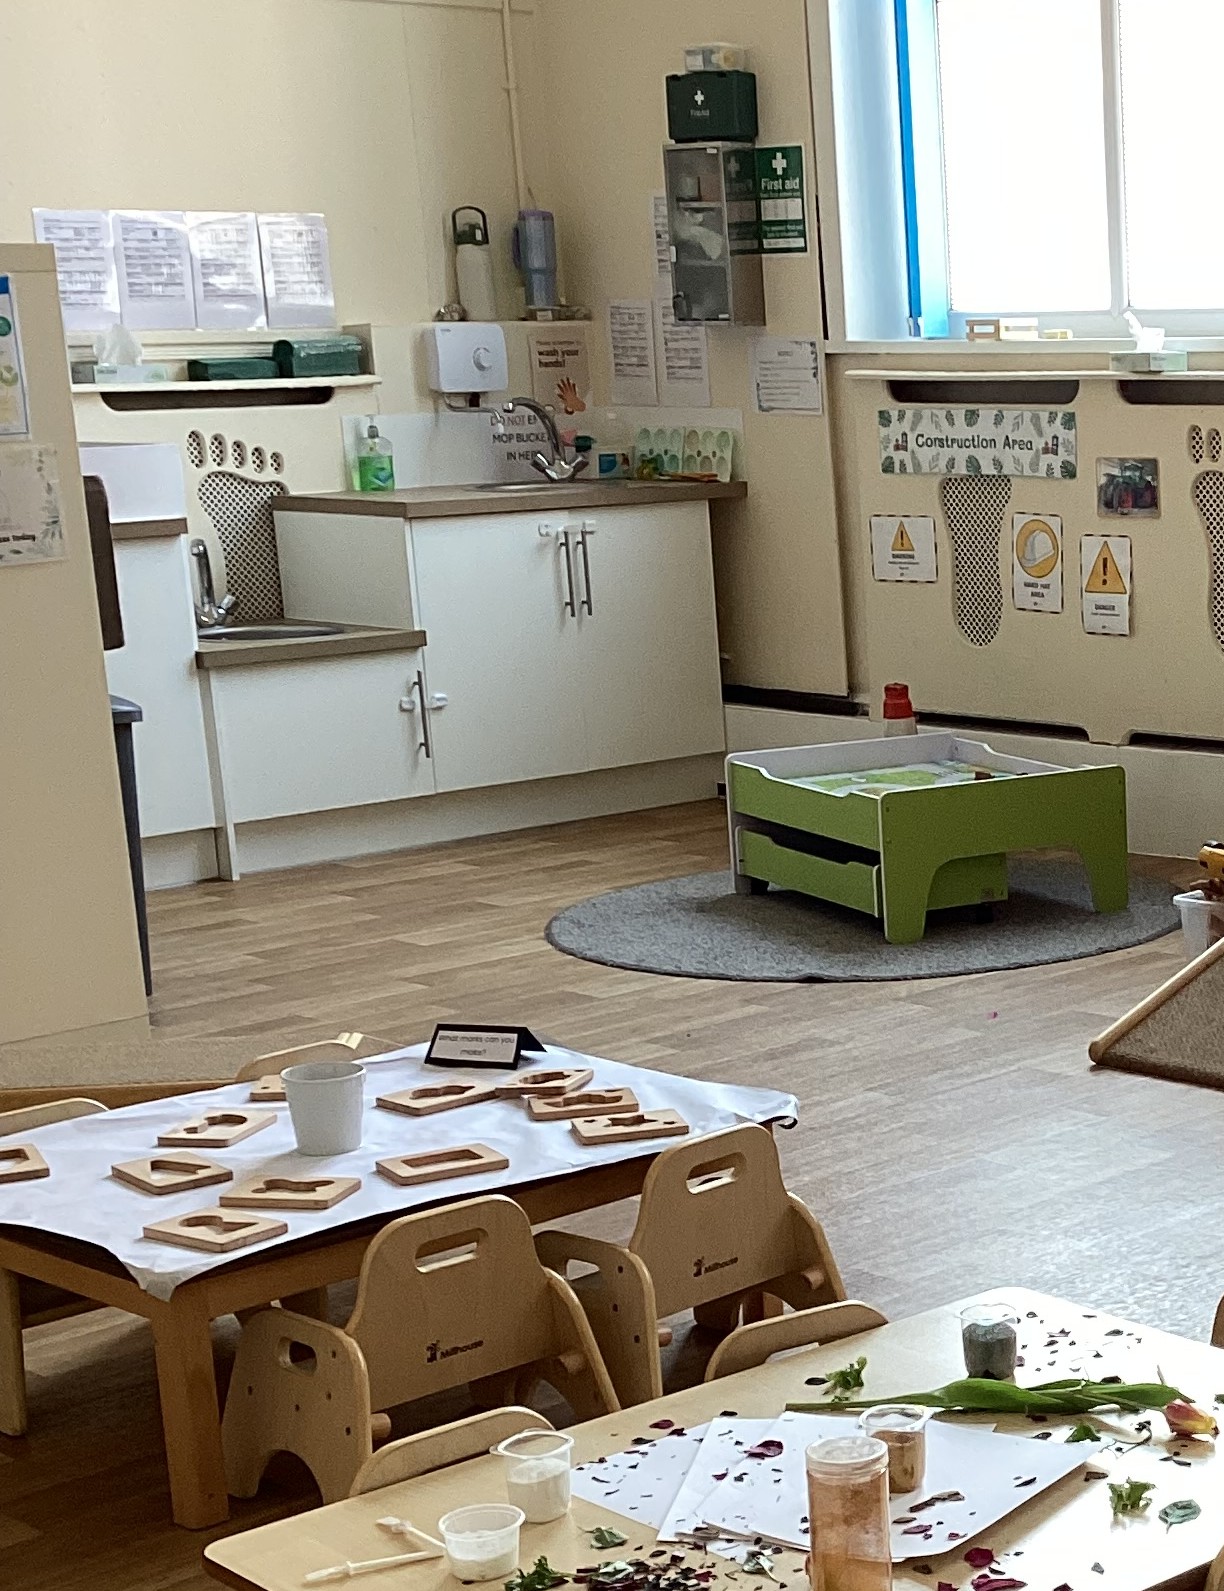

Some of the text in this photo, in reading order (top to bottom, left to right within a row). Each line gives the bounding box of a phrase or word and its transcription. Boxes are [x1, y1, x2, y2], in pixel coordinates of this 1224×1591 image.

[761, 178, 782, 190] First
[784, 177, 800, 190] aid
[492, 432, 549, 443] MOP BUCKE
[915, 433, 1033, 451] Construction Area
[507, 451, 516, 460] IN
[440, 1340, 483, 1360] Millhouse
